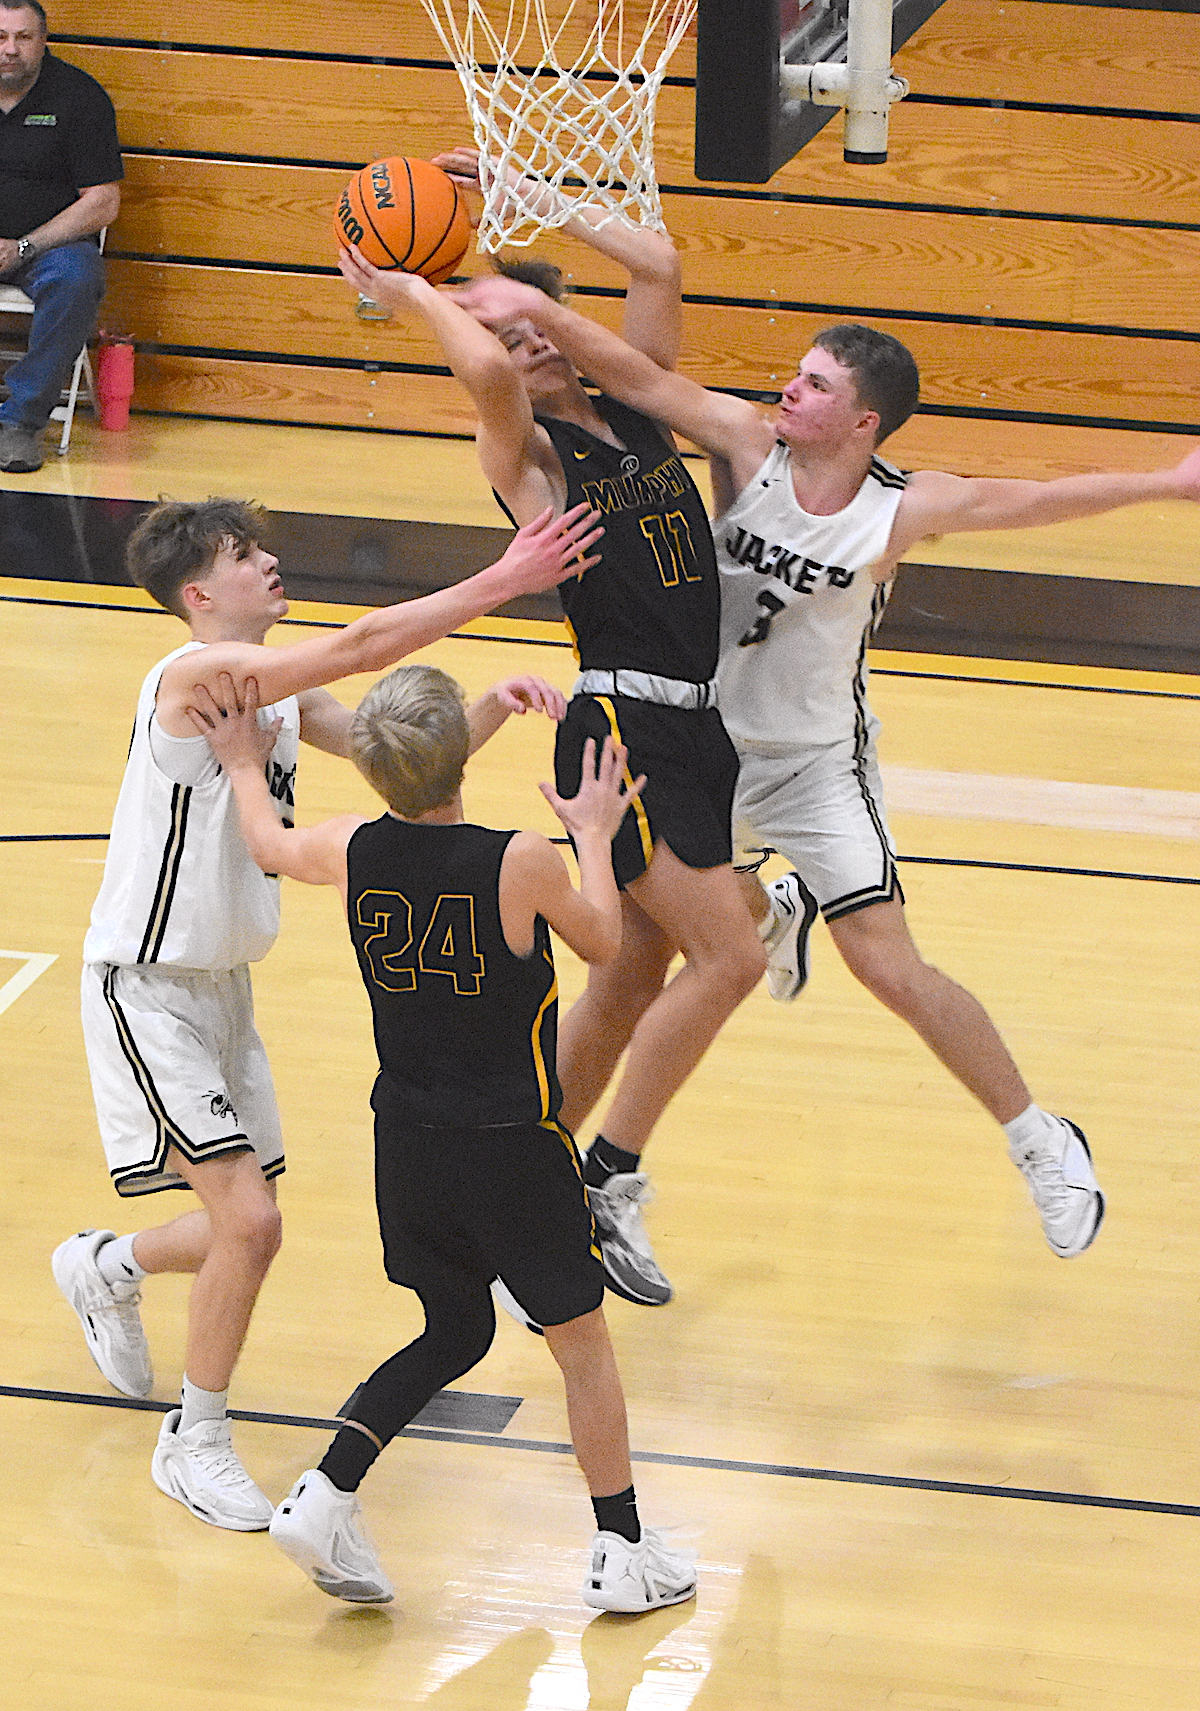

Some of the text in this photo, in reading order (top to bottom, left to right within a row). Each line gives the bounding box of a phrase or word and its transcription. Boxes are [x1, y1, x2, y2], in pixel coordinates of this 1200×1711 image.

[371, 162, 396, 210] NCAA
[337, 188, 364, 246] Wil
[639, 509, 702, 588] 11
[738, 590, 786, 648] 3
[356, 889, 485, 995] 24
